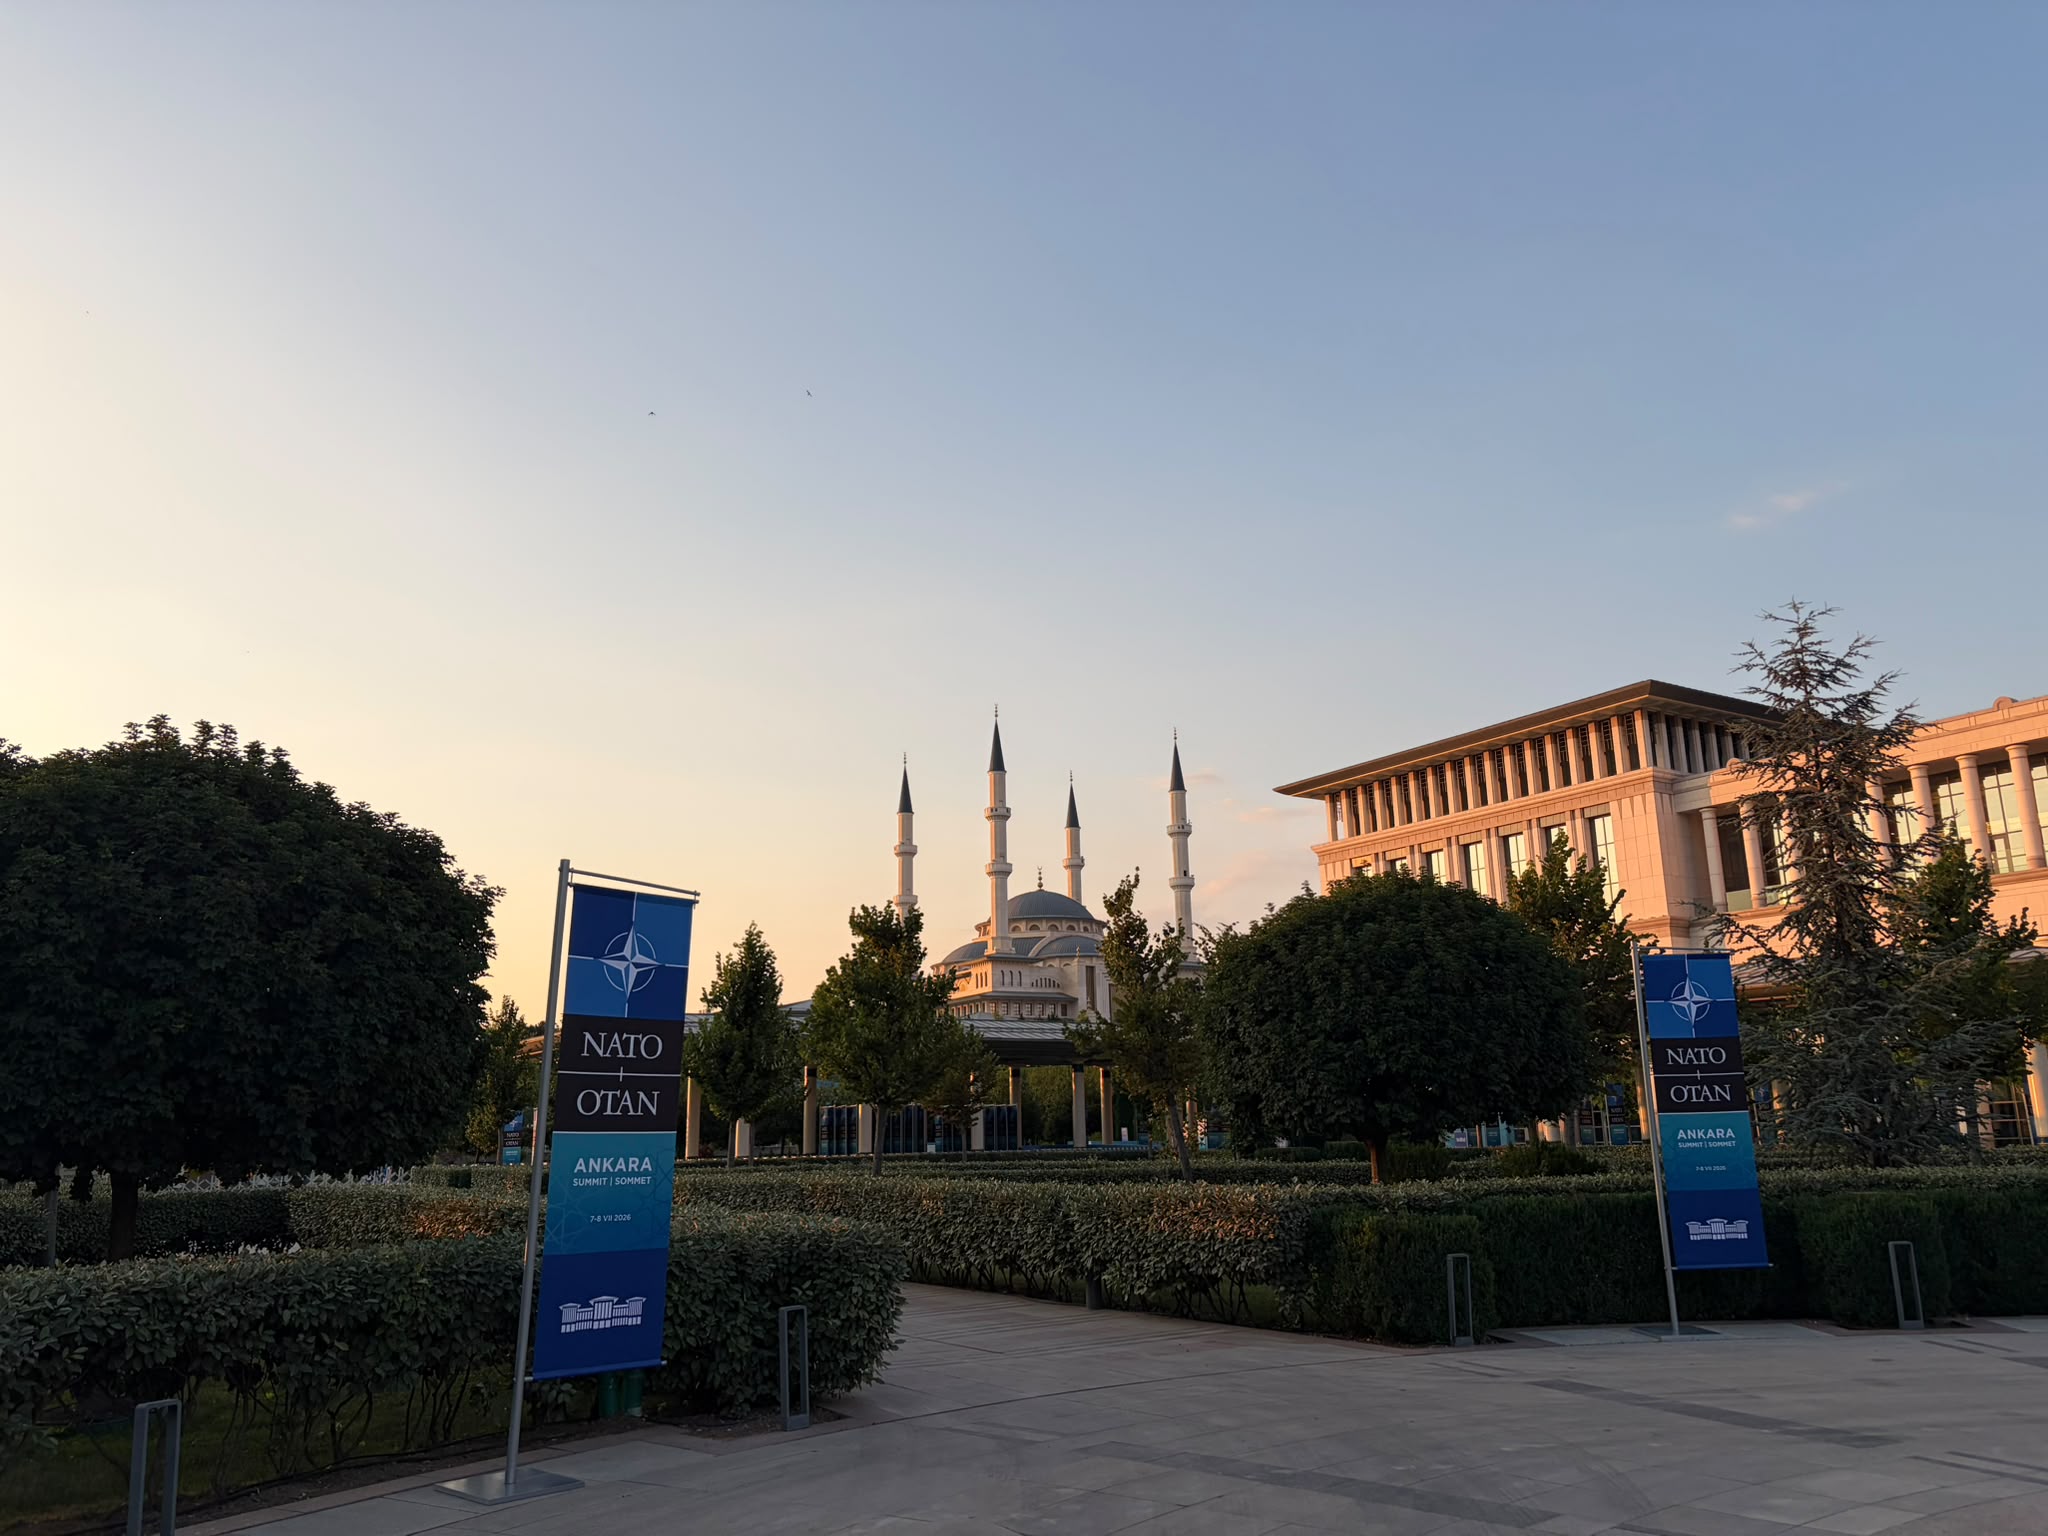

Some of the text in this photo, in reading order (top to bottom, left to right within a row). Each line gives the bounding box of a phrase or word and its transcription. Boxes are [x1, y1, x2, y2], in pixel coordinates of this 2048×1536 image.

[581, 1031, 663, 1060] NATO
[1665, 1046, 1727, 1065] NATO
[576, 1089, 660, 1116] OTAN
[1670, 1084, 1731, 1103] OTAN
[1677, 1128, 1736, 1140] ANKARA
[1678, 1141, 1703, 1149] SUMMIT
[1708, 1140, 1736, 1148] SOMMET
[573, 1156, 653, 1174] ANKARA
[572, 1177, 608, 1187] SUMMIT
[614, 1176, 652, 1186] SOMMET
[590, 1213, 632, 1223] 7-8 VII 2026
